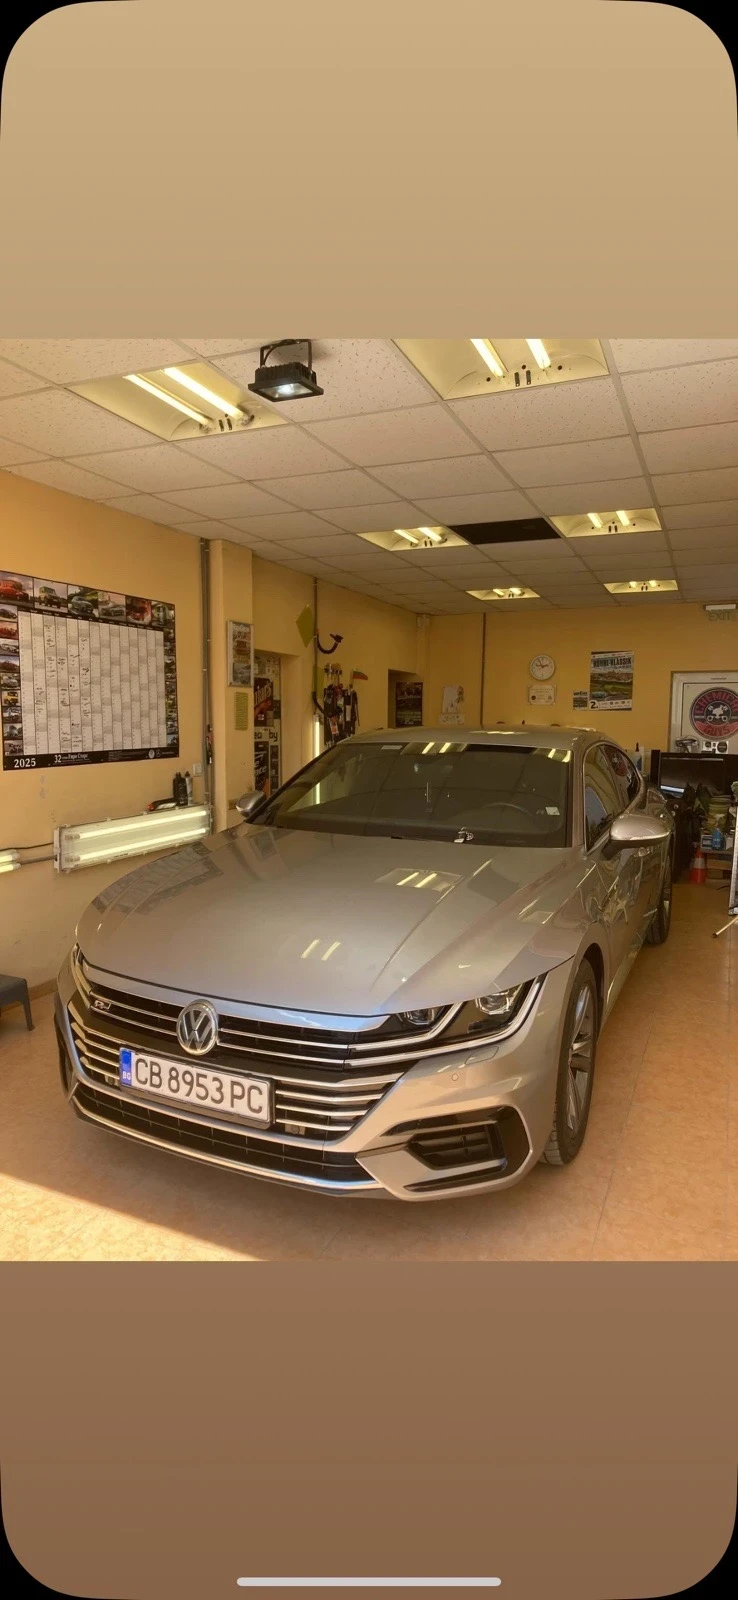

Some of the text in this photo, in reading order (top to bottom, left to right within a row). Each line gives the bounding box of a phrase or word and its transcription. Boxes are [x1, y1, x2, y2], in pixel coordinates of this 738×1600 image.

[708, 611, 731, 621] EXIT
[269, 728, 278, 742] by
[704, 724, 731, 736] GUYS
[14, 757, 36, 768] 2025
[54, 754, 62, 763] 32
[122, 1071, 131, 1081] BG
[135, 1058, 263, 1114] CB 8953 PC
